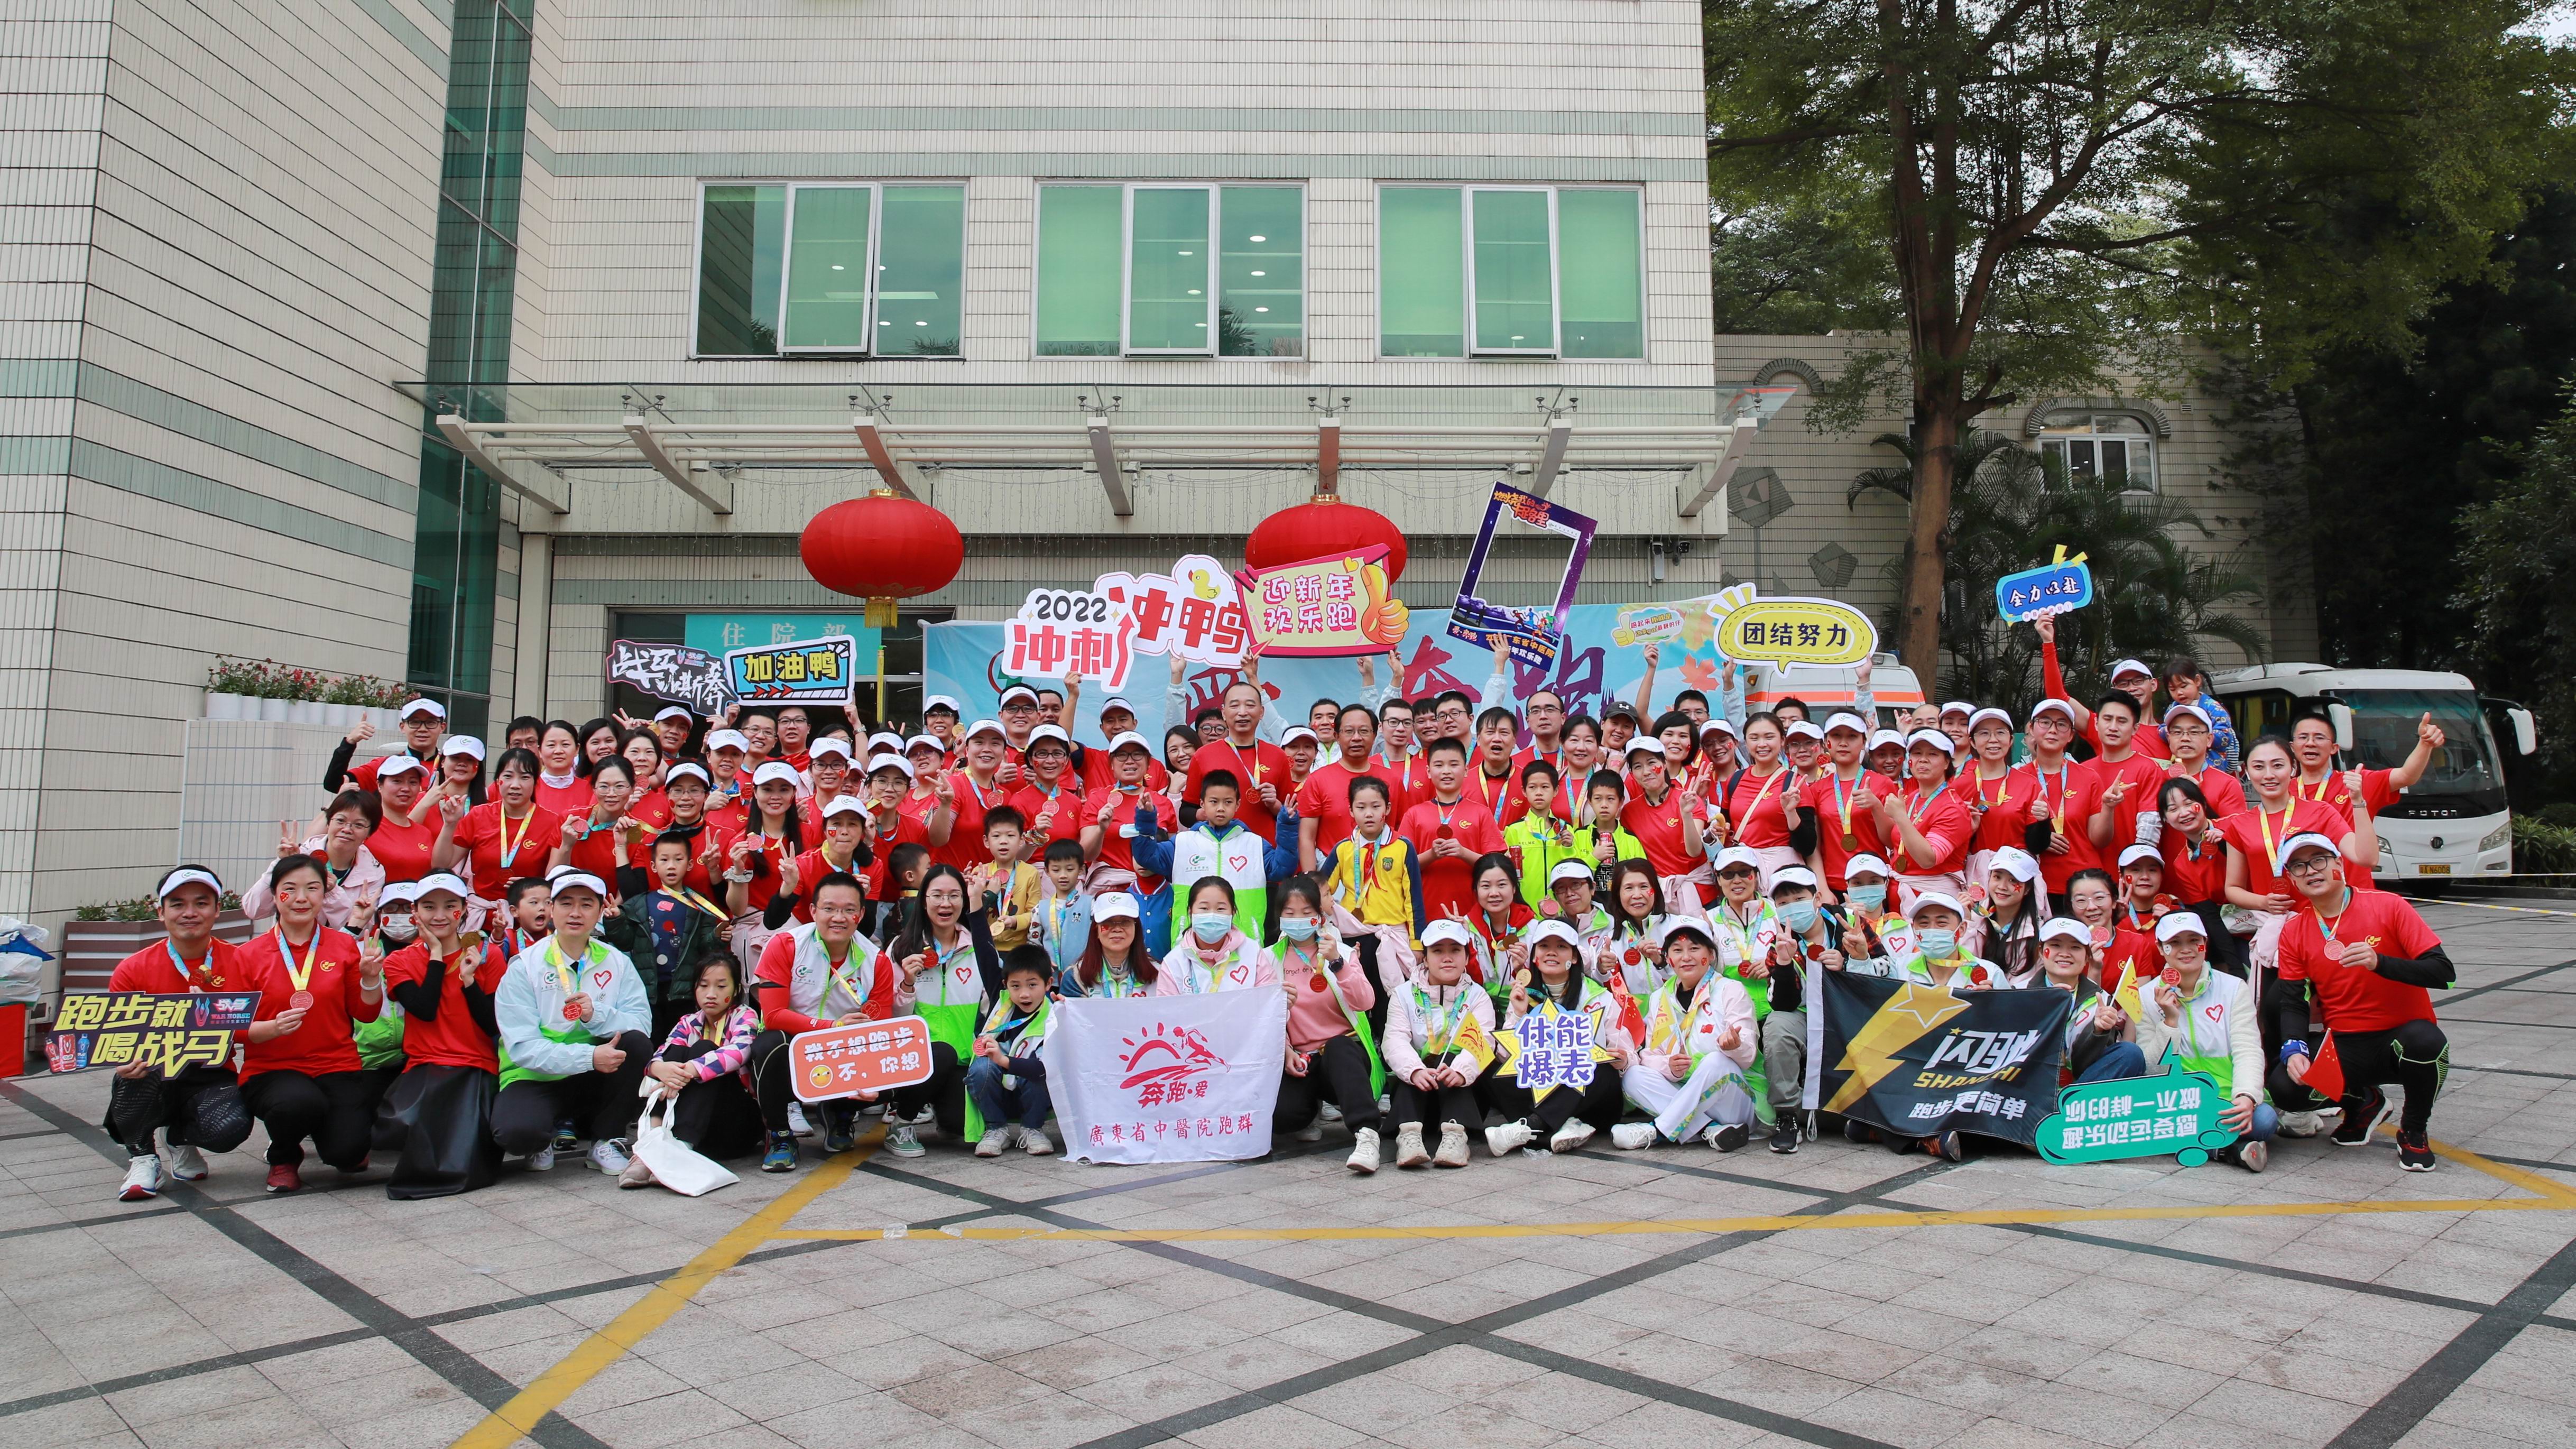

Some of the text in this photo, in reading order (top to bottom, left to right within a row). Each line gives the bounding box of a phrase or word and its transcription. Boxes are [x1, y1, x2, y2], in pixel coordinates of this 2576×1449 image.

[1263, 574, 1355, 604] 迎新年
[2009, 576, 2081, 607] 全力以赴
[1035, 594, 1107, 623] 2022
[1109, 586, 1247, 654] 冲鸭
[1263, 602, 1356, 634] 欢乐跑
[1011, 624, 1113, 675] 冲刺
[1743, 622, 1846, 647] 团结努力
[744, 649, 839, 683] 加油鸭
[53, 994, 193, 1031] 跑步就
[1518, 1016, 1591, 1048] 体能
[90, 1030, 232, 1078] 喝战马
[1518, 1049, 1592, 1085] 爆表
[1908, 1091, 2027, 1120] 跑步更简单
[2065, 1087, 2201, 1122] 做不一样的你
[1090, 1113, 1253, 1147] 廣東省中醫院跑群
[2062, 1114, 2198, 1149] 感受运动乐趣
